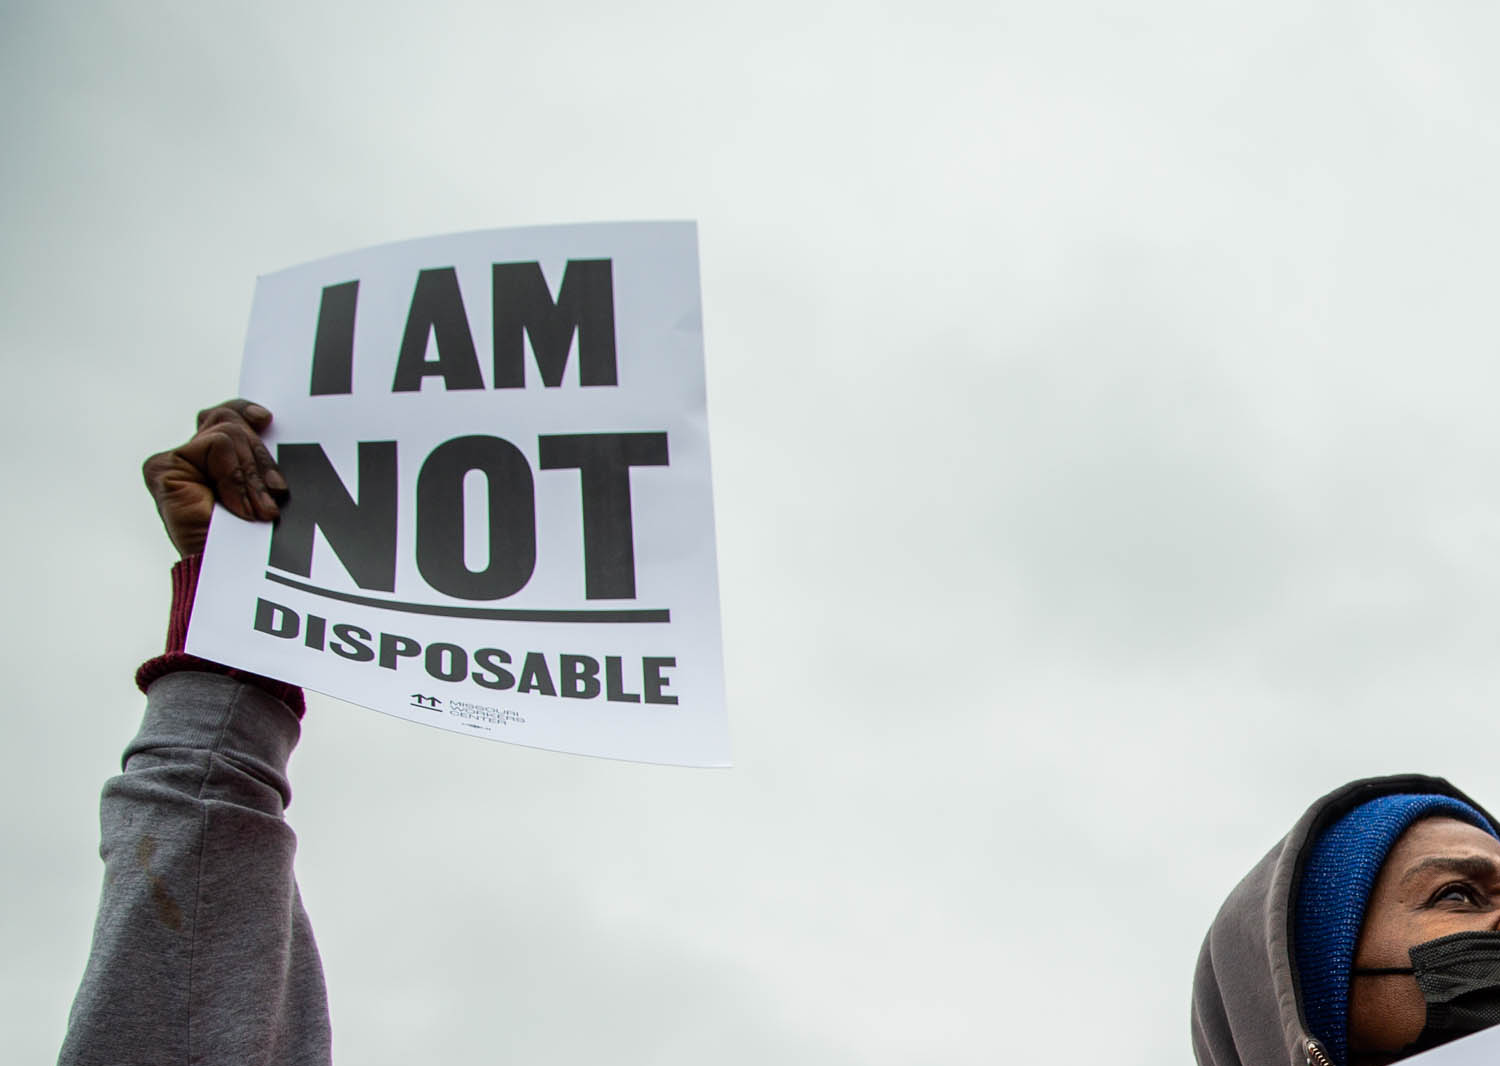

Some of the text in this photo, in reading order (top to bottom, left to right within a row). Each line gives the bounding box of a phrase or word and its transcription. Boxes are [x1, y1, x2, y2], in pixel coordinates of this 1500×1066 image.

[310, 258, 618, 396] I AM
[267, 431, 670, 601] NOT
[253, 597, 679, 705] DISPOSABLE
